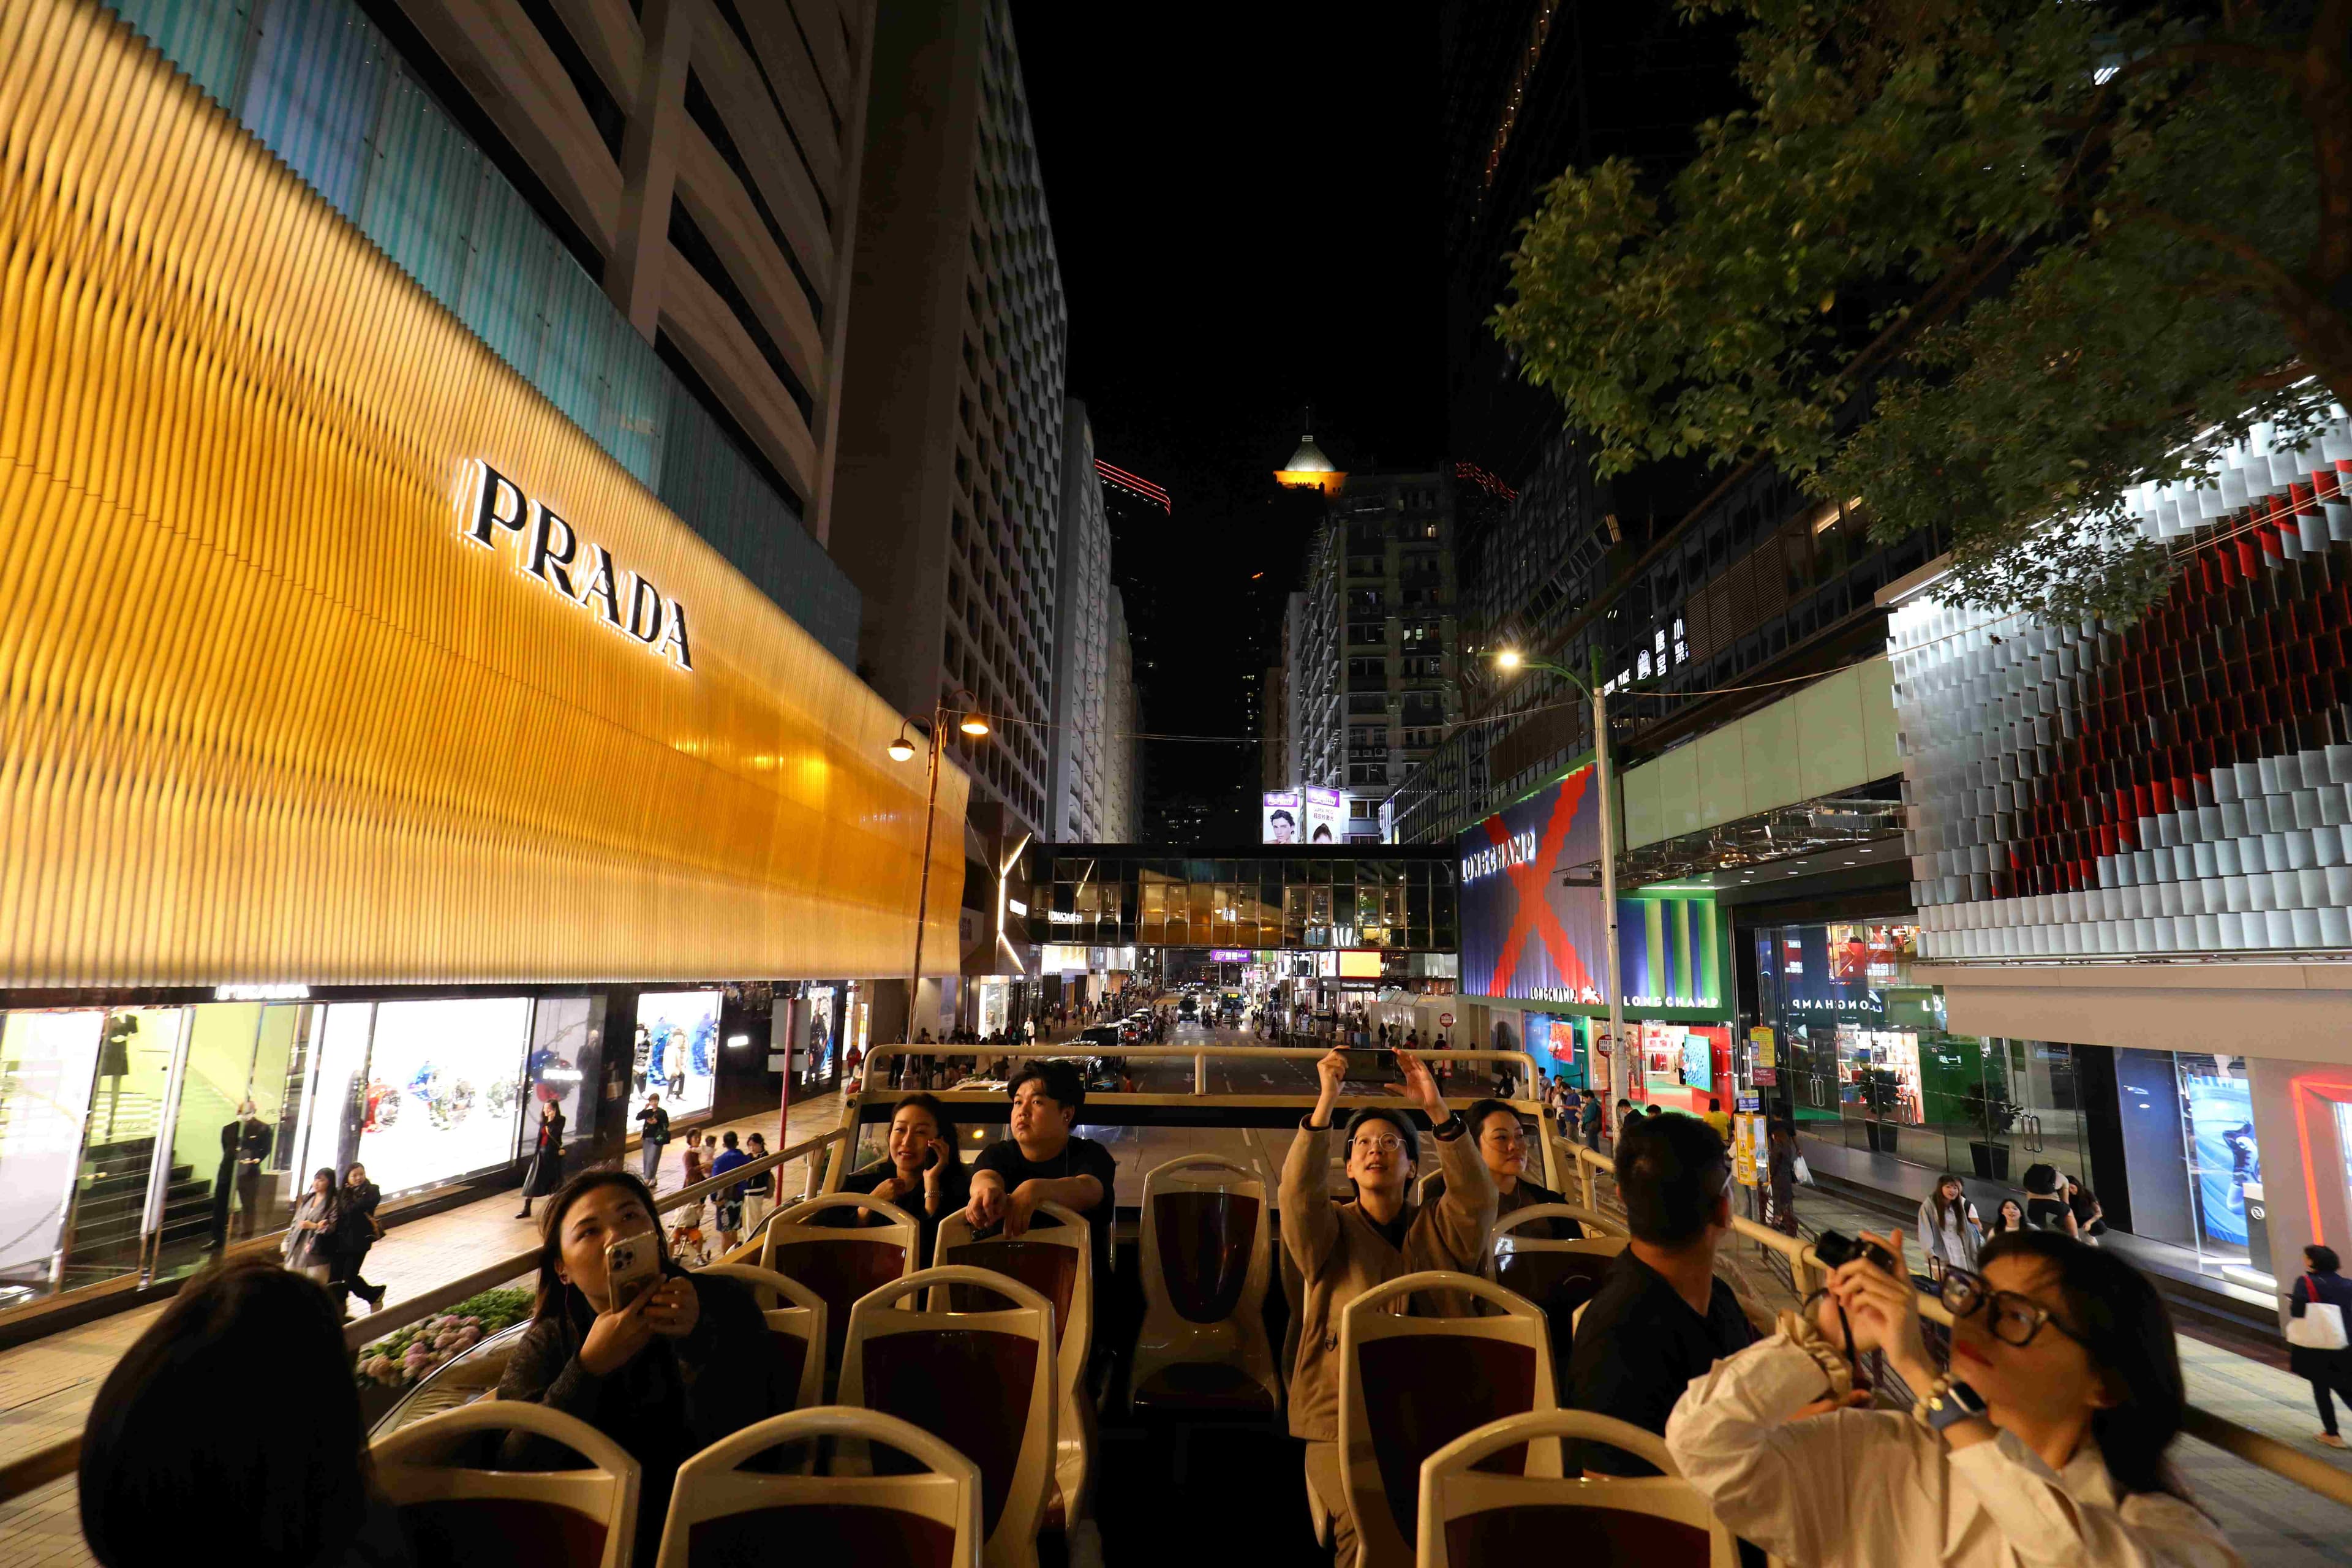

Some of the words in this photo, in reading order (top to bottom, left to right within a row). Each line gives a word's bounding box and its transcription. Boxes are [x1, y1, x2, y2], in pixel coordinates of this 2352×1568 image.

[464, 458, 693, 672] PRADA
[1461, 832, 1535, 882] LONGCHAMP
[1531, 987, 1576, 1003] LONGCHAMP
[1623, 995, 1719, 1008] LONGCHAMP
